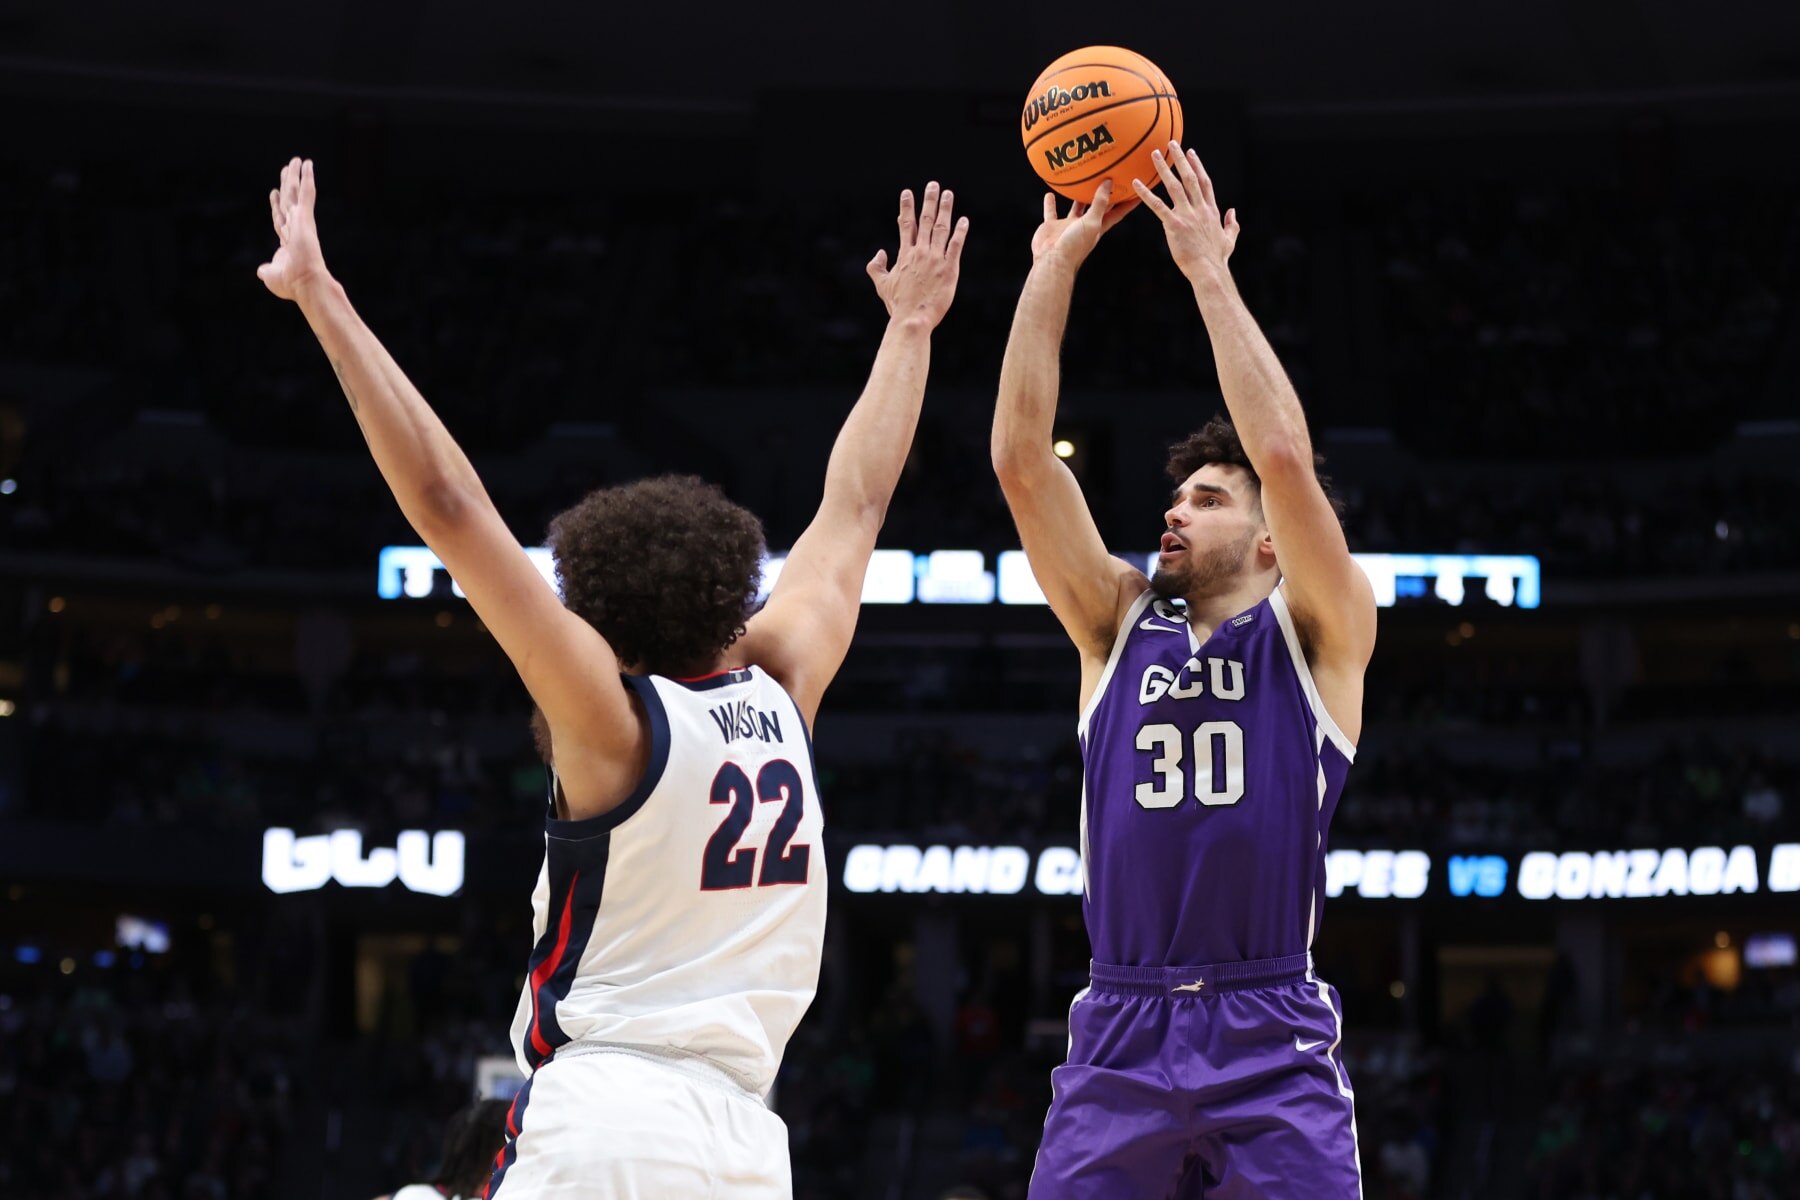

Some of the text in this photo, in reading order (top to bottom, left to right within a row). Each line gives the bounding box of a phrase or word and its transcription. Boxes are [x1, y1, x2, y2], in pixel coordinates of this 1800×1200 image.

[1024, 80, 1112, 131] Wilson
[1044, 124, 1115, 171] NCAA
[1139, 656, 1245, 706] GCU
[1134, 720, 1245, 809] 30
[700, 758, 811, 892] 22
[843, 845, 1029, 894] GRAND
[1325, 850, 1430, 898] PES
[1448, 855, 1507, 897] VS
[1517, 846, 1759, 900] GONZAGA
